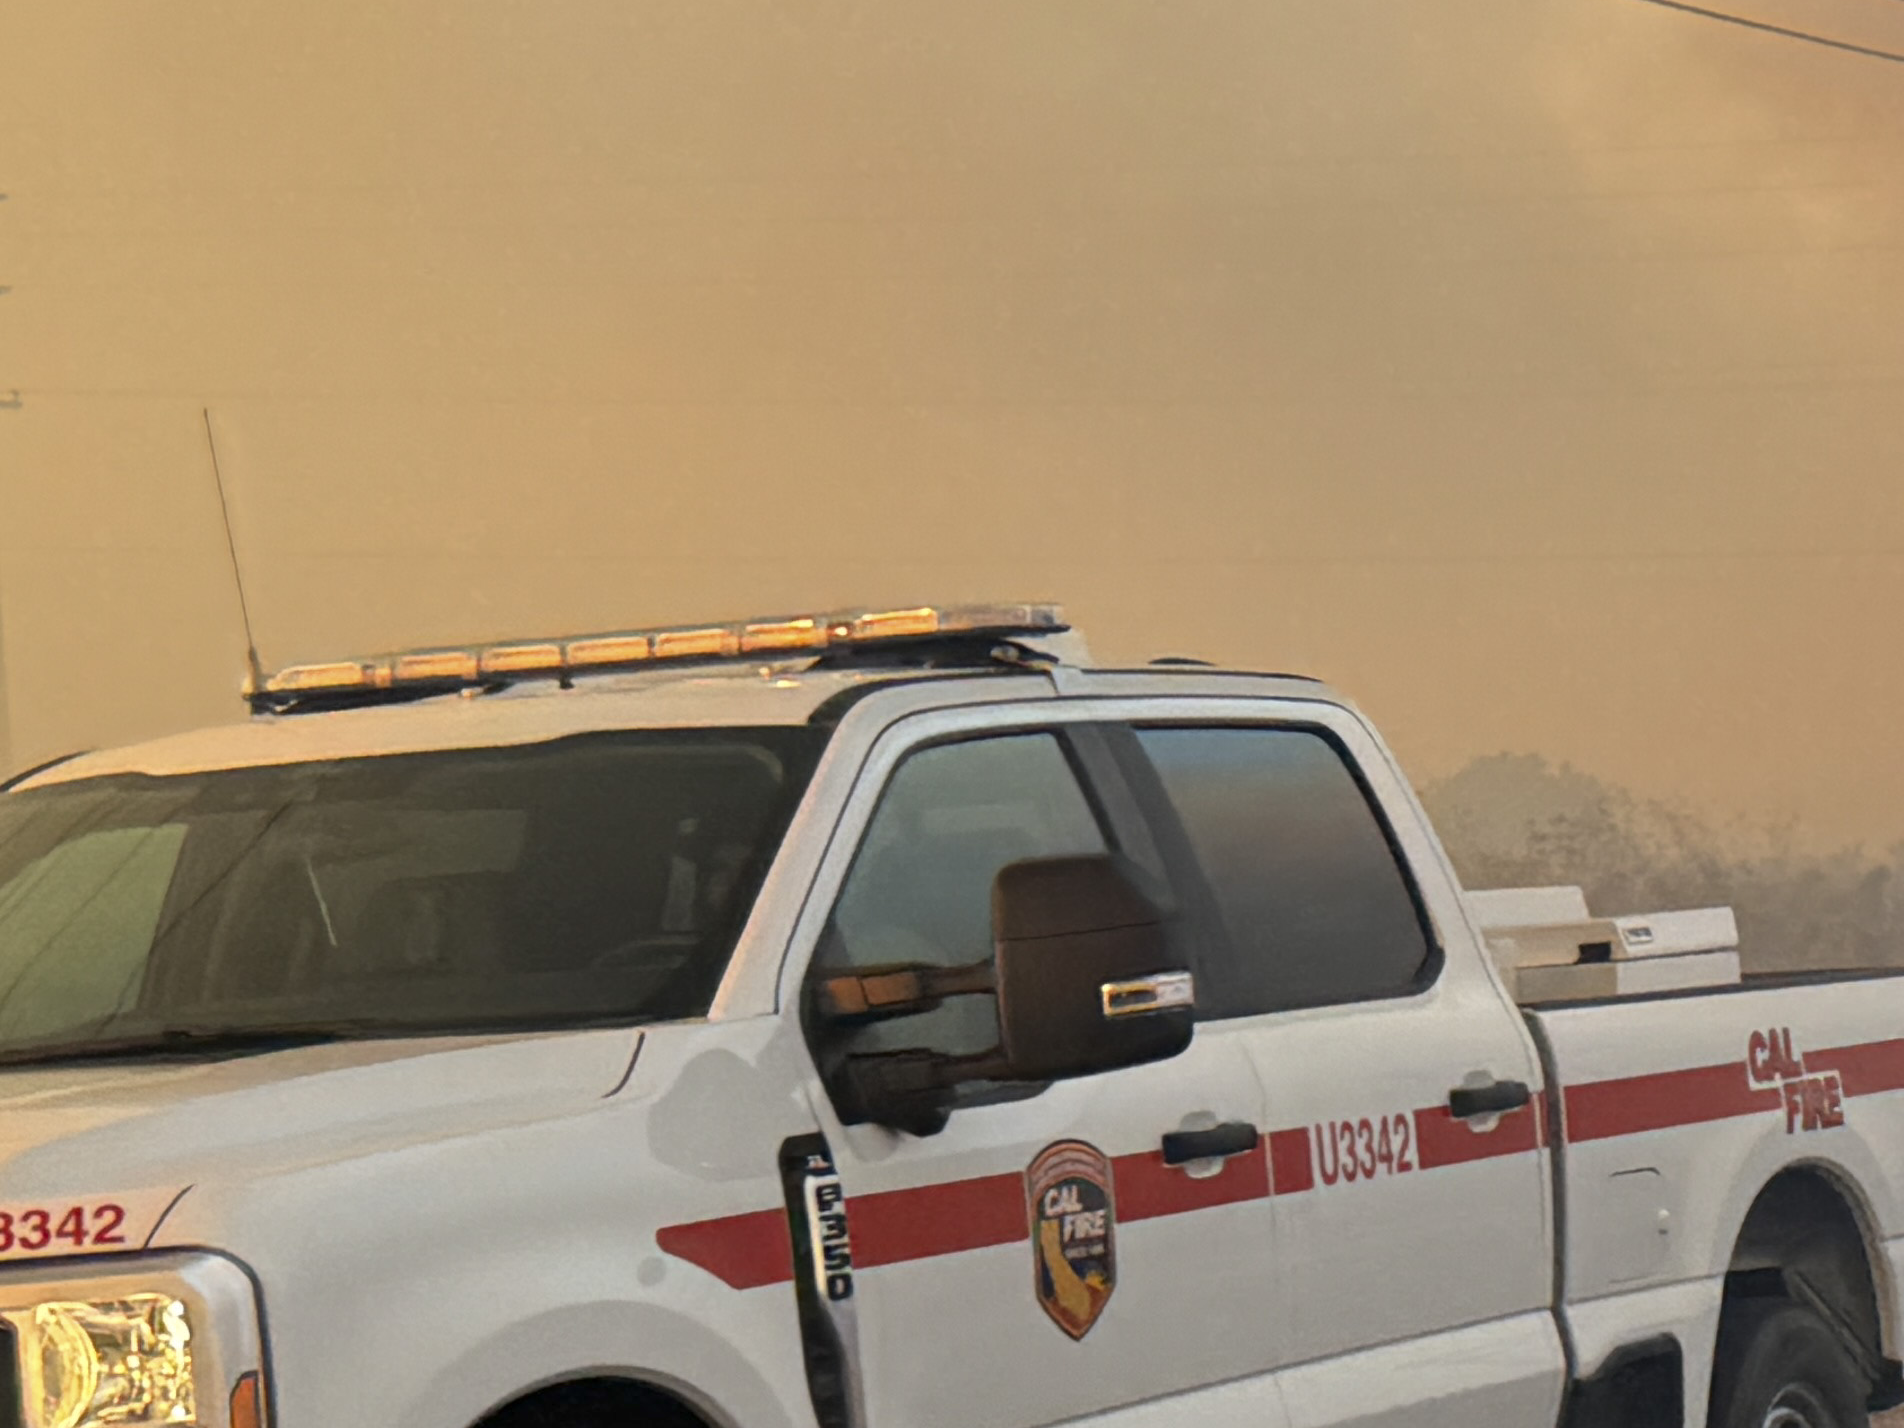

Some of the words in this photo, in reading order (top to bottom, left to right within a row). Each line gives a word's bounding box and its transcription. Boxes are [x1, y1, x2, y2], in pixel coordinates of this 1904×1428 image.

[1748, 1027, 1803, 1084] CAL
[1783, 1076, 1845, 1135] FIRE
[1314, 1113, 1413, 1186] U3342
[1044, 1183, 1084, 1217] CAL
[1062, 1209, 1106, 1244] FIRE
